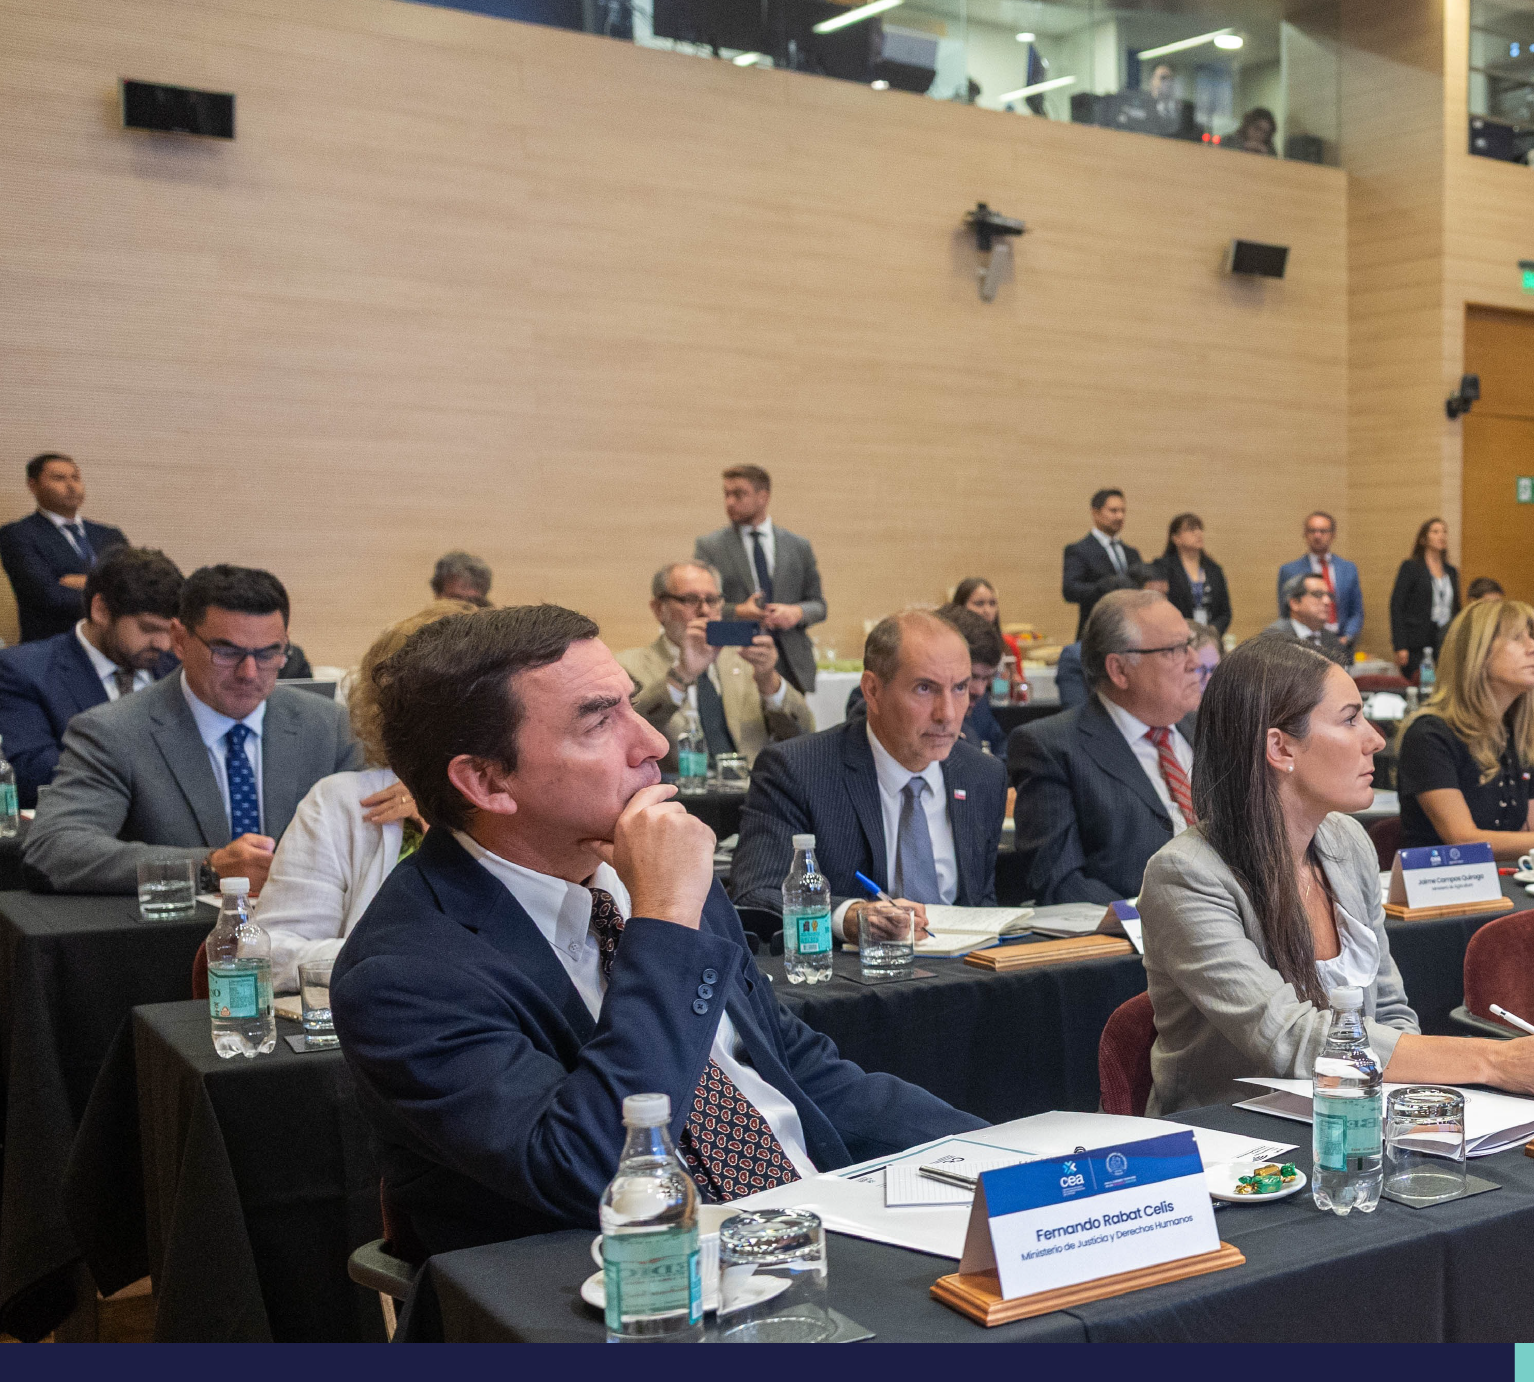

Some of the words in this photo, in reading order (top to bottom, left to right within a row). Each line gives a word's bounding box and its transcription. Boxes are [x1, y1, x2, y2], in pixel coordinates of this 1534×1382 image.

[1060, 1174, 1084, 1187] cea
[1021, 1245, 1063, 1261] Ministerio
[1063, 1241, 1076, 1251] de
[1078, 1234, 1108, 1248] Justicia
[1109, 1234, 1115, 1243] y
[1116, 1223, 1154, 1240] Derechos
[1155, 1215, 1193, 1230] Humanos
[1036, 1218, 1101, 1242] Fernando
[1102, 1208, 1142, 1226] Rabat
[1143, 1201, 1174, 1217] Celis
